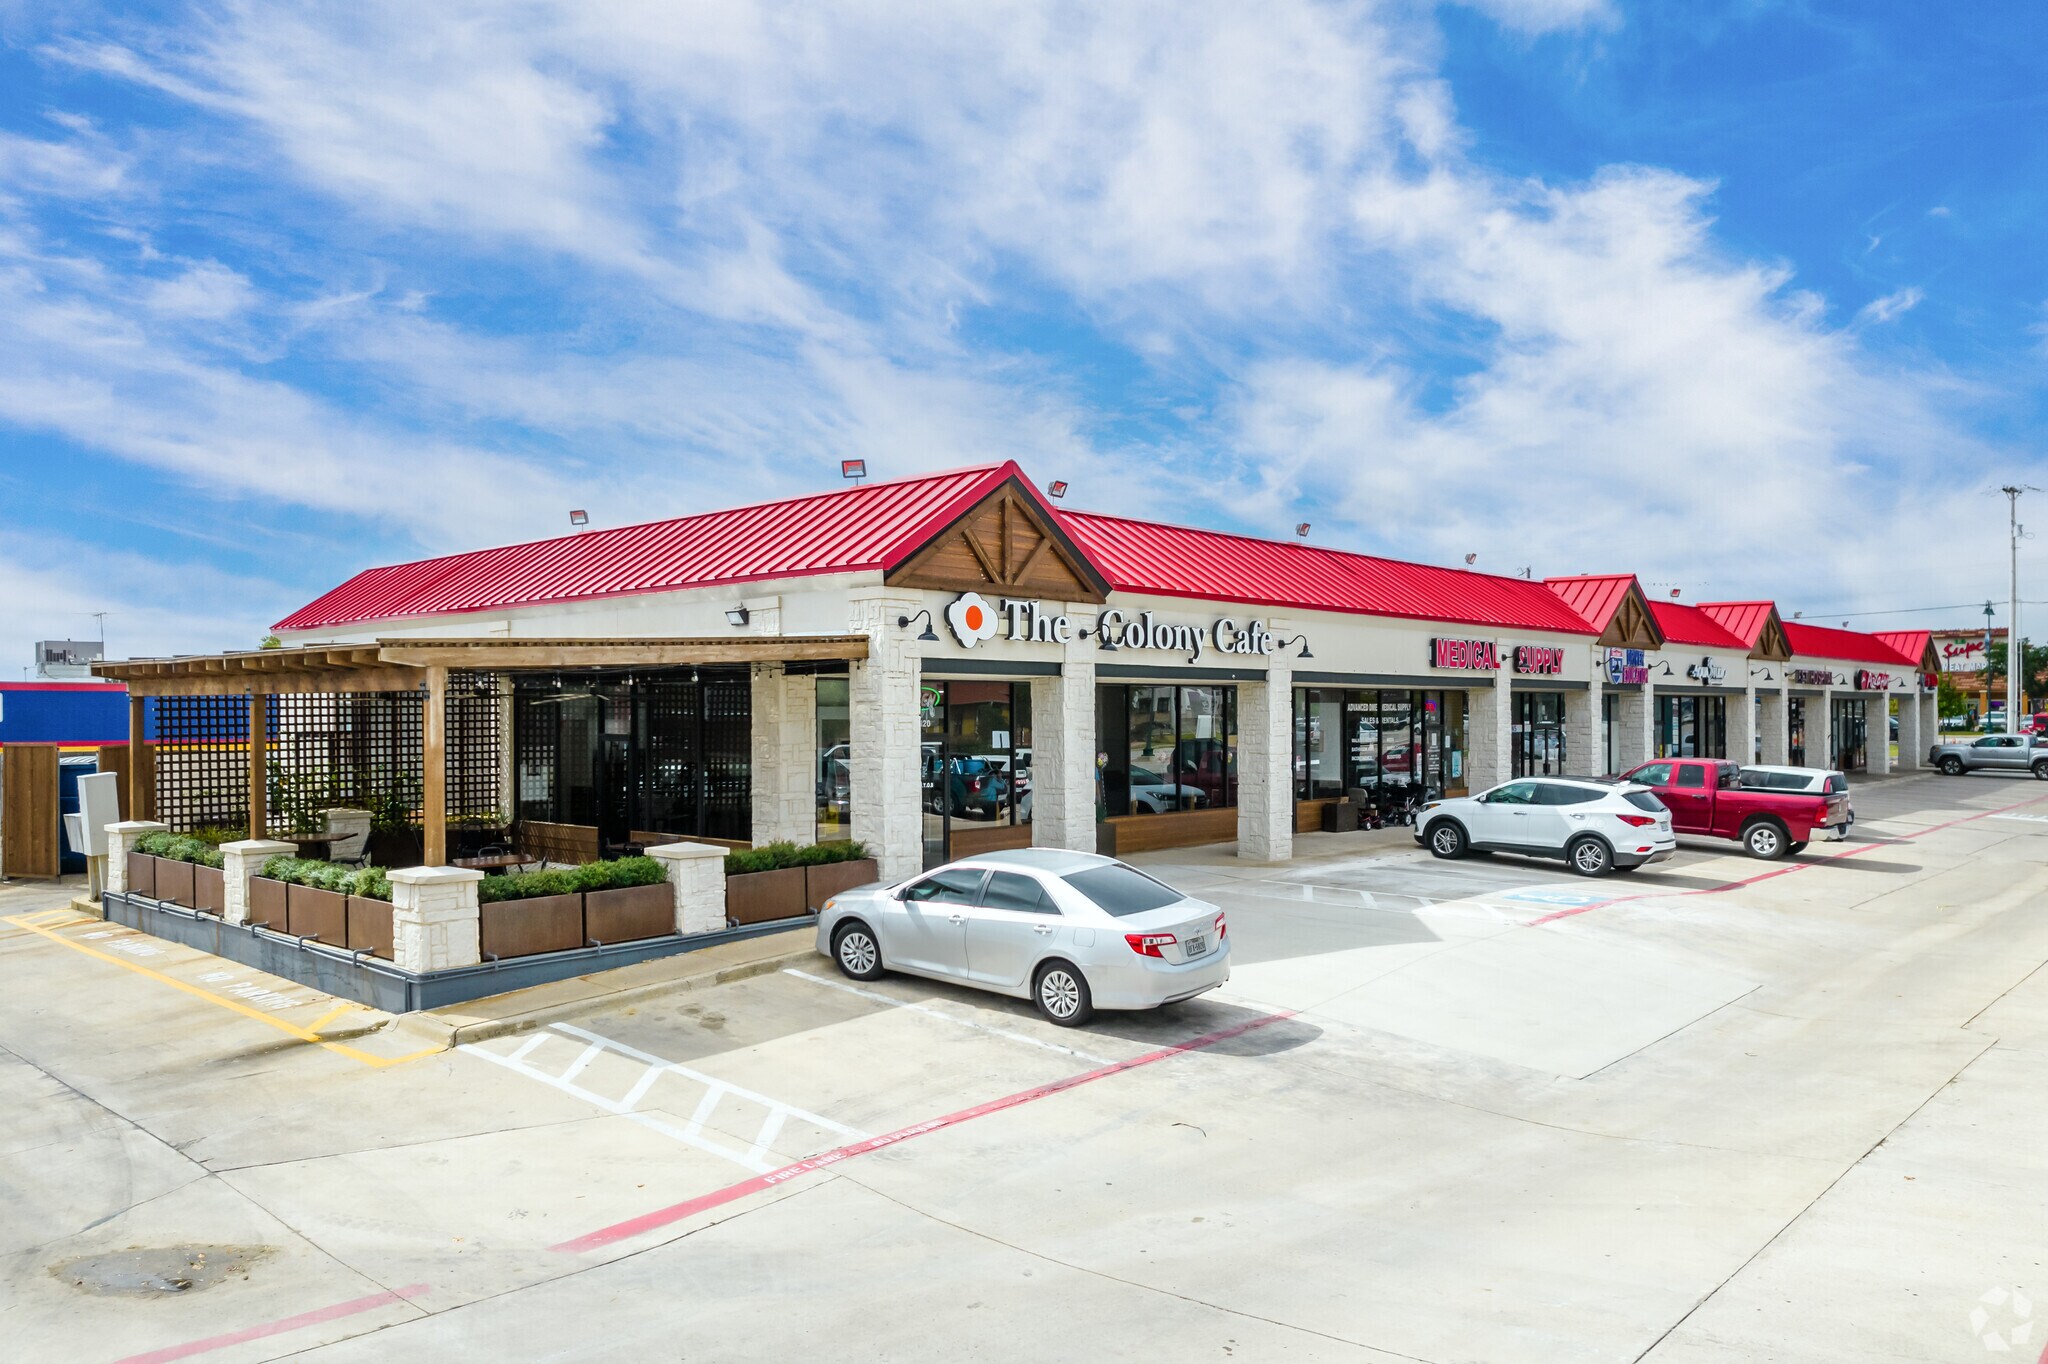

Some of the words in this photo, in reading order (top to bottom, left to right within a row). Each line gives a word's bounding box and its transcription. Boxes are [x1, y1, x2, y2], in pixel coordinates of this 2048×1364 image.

[1001, 599, 1072, 644] The
[1099, 609, 1208, 665] Colony
[1212, 617, 1274, 656] Cafe
[1436, 638, 1501, 670] MEDICAL
[1518, 646, 1565, 674] SUPPLY
[1943, 640, 1994, 659] Supe
[1347, 703, 1369, 712] ADVANCED
[1398, 703, 1412, 712] SUPPLY
[1361, 716, 1376, 724] SALES
[764, 1167, 804, 1184] FIRE
[803, 1152, 846, 1169] LANE
